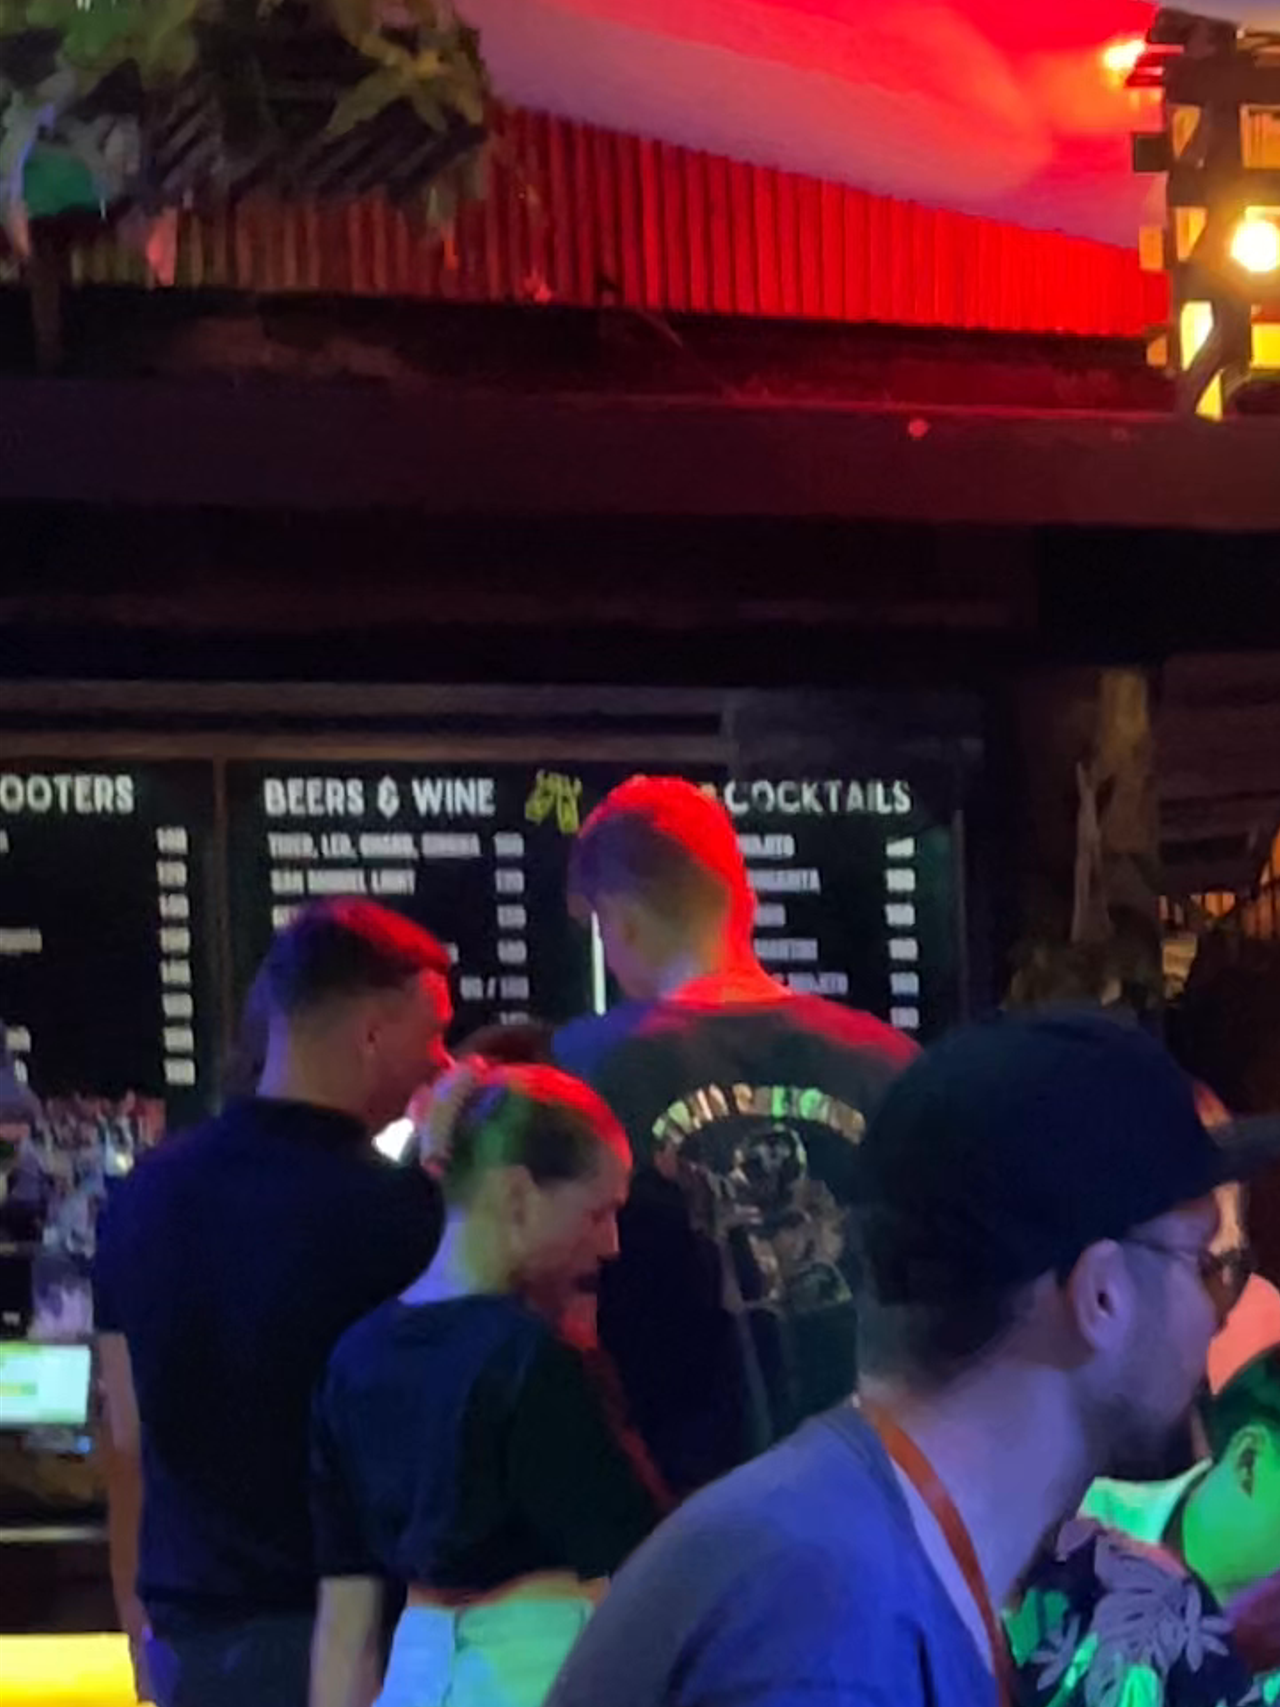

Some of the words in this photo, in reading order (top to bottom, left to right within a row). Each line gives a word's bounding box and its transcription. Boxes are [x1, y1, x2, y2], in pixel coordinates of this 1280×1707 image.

[263, 777, 366, 817] BEERS
[411, 777, 497, 817] WINE
[723, 779, 912, 815] COCKTAILS
